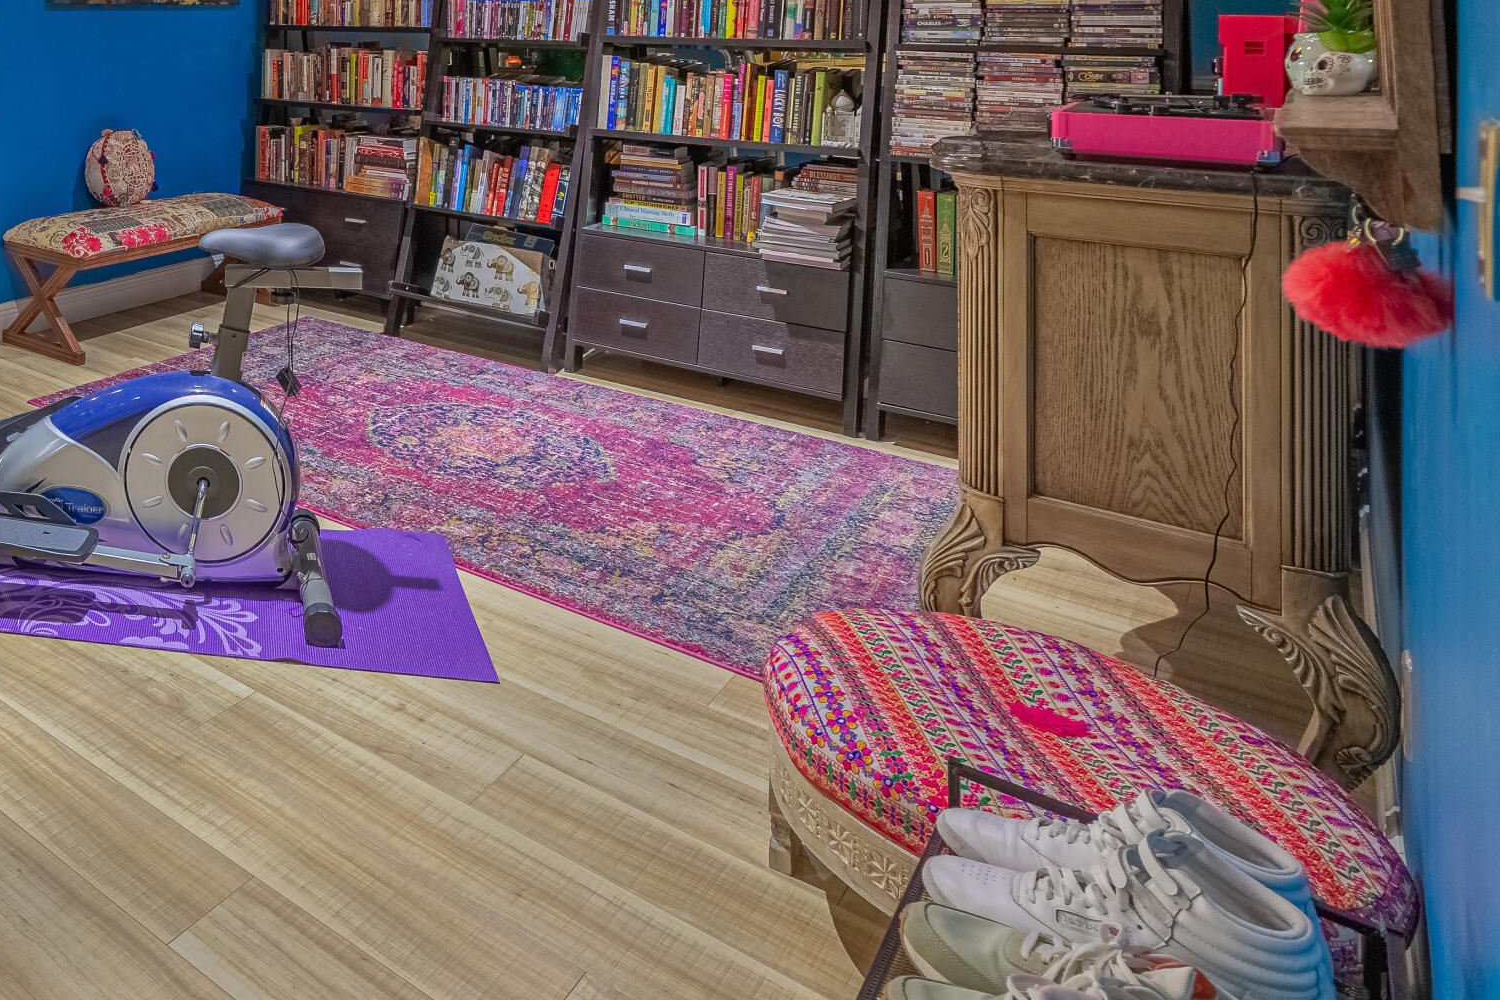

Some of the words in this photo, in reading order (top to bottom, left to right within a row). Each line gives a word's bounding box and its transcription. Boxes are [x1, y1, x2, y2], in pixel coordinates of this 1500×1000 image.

[1078, 72, 1104, 81] COSBY
[645, 86, 654, 103] INDIA
[774, 89, 785, 111] LUCKY
[772, 112, 784, 128] BOY
[809, 171, 840, 179] BLESSINGS
[619, 205, 639, 213] Clinical
[640, 207, 659, 215] Nursing
[660, 209, 674, 217] Skills
[628, 219, 650, 230] Indian
[65, 502, 103, 513] Trainer
